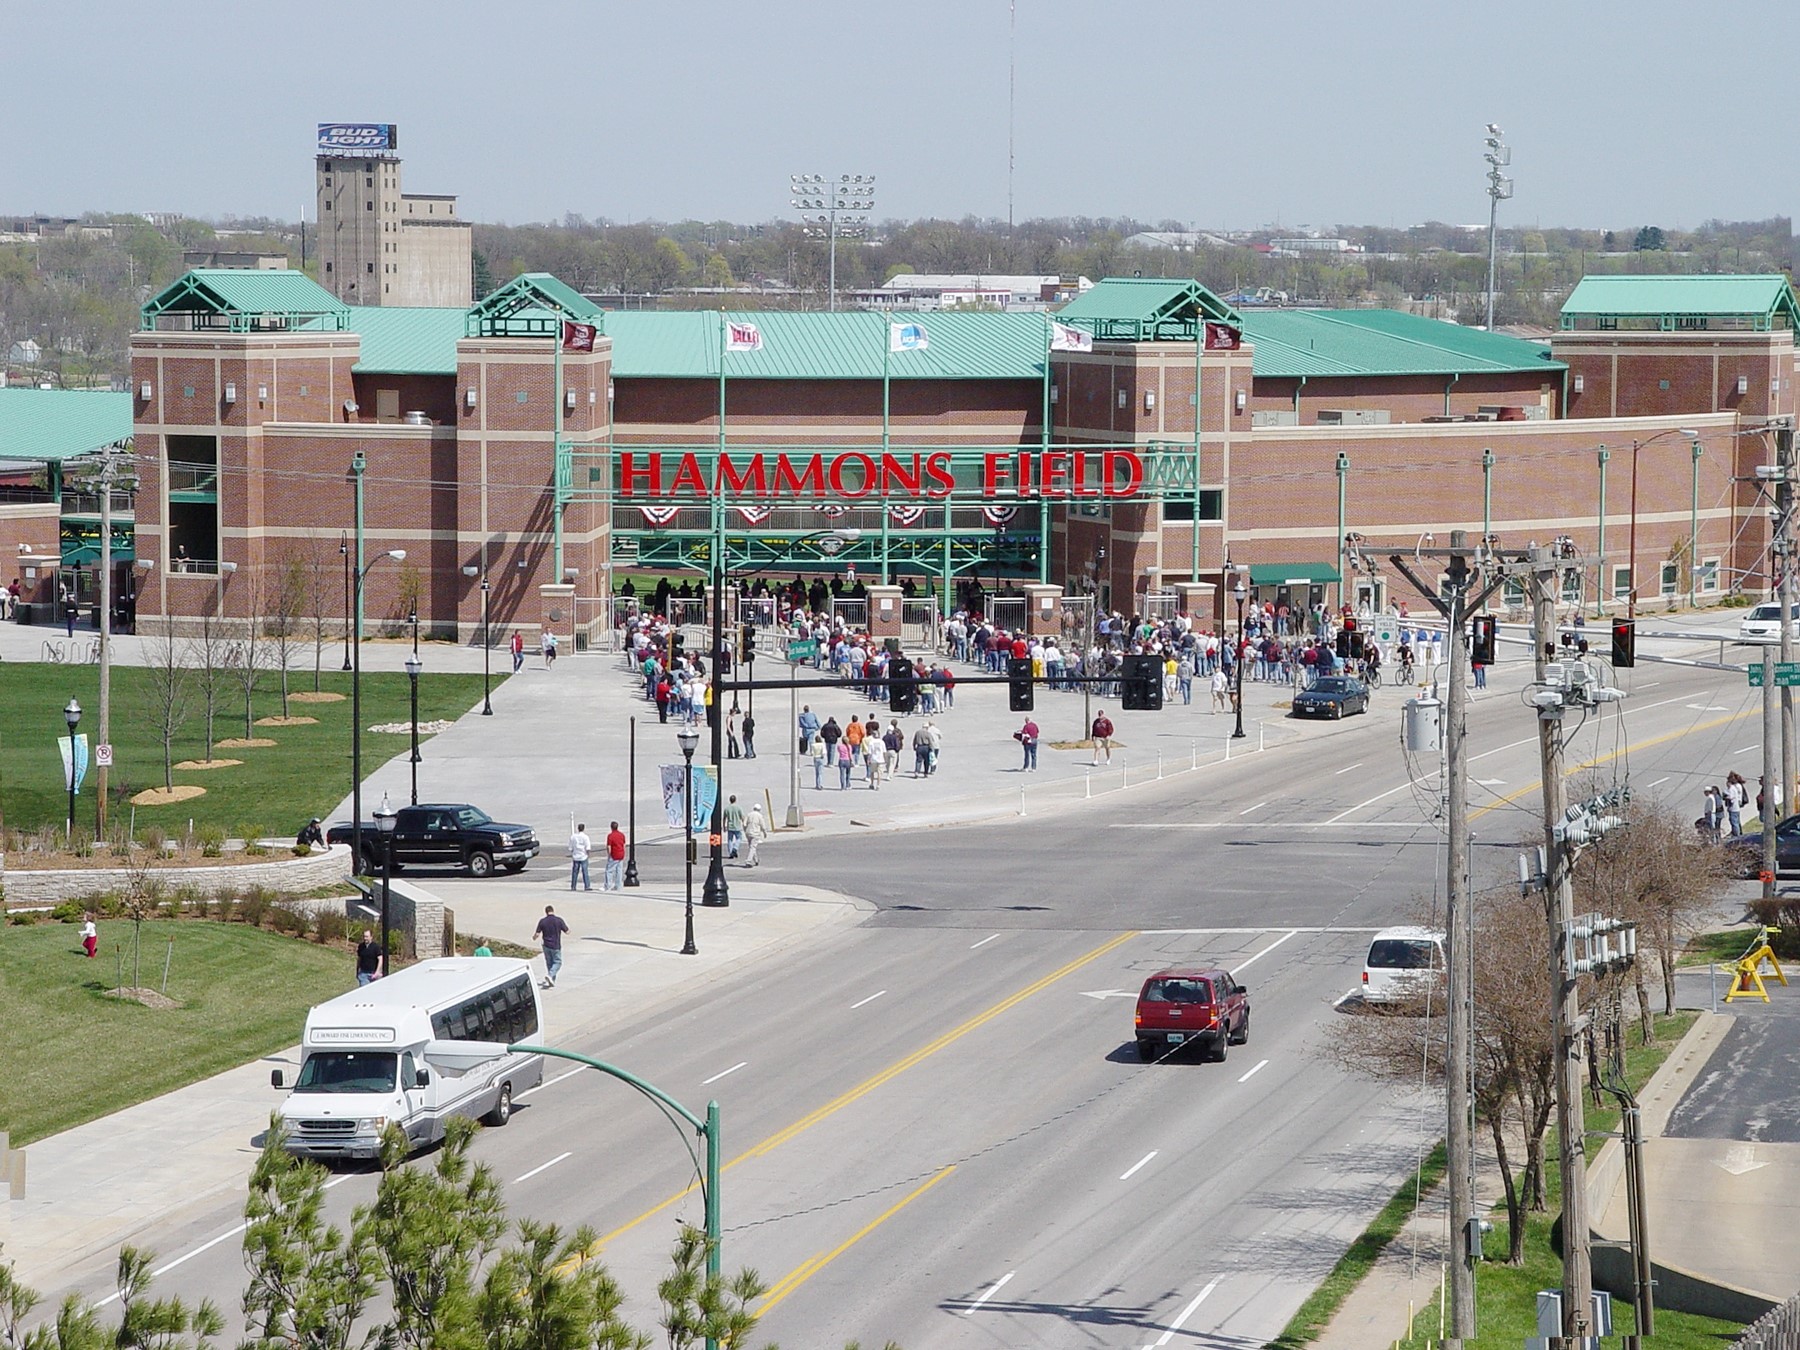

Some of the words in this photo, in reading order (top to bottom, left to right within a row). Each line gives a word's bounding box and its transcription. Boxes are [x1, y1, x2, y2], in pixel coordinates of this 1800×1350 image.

[330, 128, 378, 136] BUD
[319, 136, 385, 144] LIGHT
[620, 451, 955, 498] HAMMONS
[982, 450, 1144, 498] FIELD
